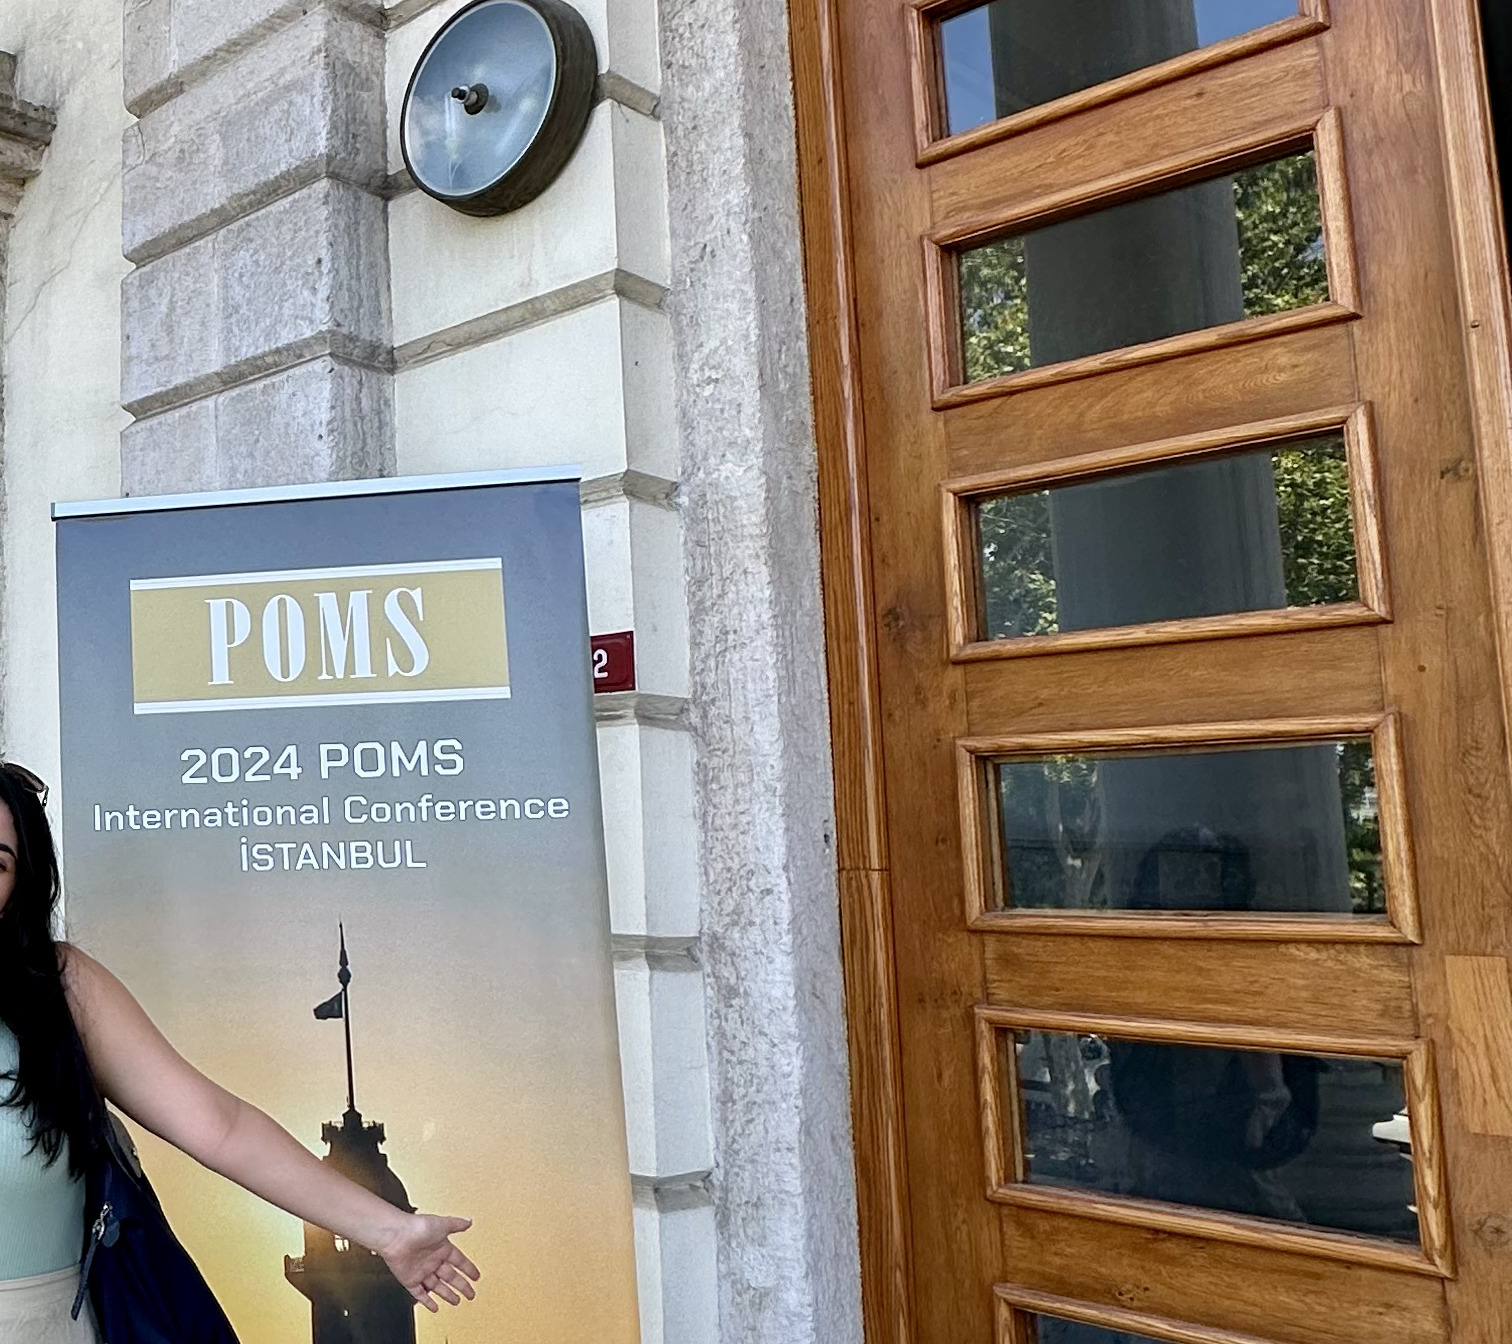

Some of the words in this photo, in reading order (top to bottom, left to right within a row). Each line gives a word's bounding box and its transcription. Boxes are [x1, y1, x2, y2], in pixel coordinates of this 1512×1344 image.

[204, 587, 430, 686] POMS
[593, 649, 609, 679] 2
[180, 744, 303, 785] 2024
[319, 738, 464, 779] POMS
[93, 796, 330, 832] International
[343, 793, 570, 823] Conference
